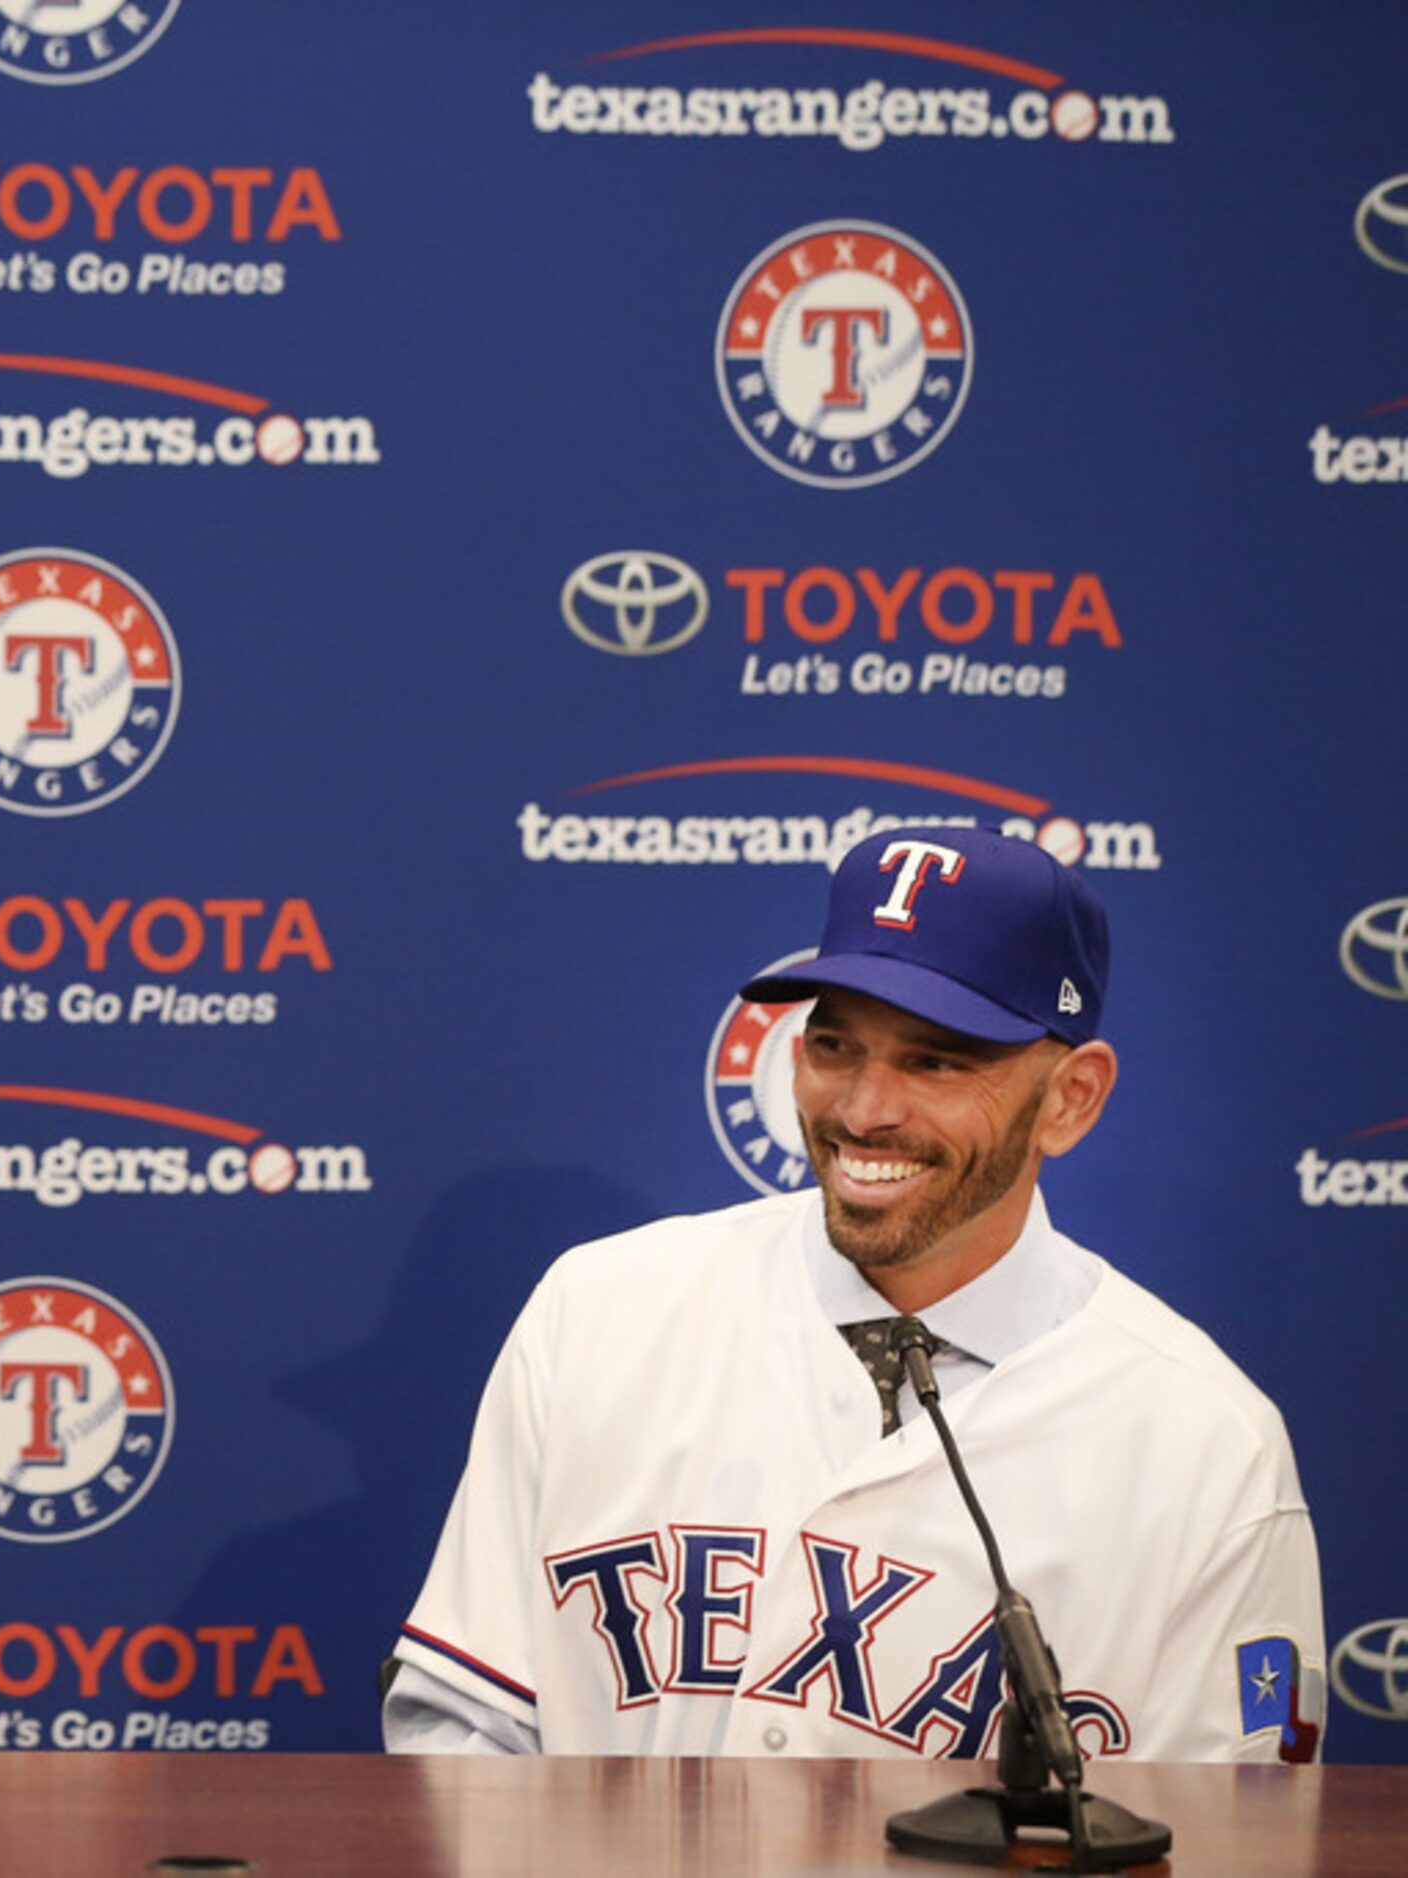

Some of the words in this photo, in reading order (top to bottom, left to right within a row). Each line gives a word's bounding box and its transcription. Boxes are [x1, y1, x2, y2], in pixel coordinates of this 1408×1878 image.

[527, 73, 1174, 150] texasrangers.com
[65, 251, 131, 294] Go
[136, 253, 285, 296] Places
[756, 236, 933, 305] TEXAS
[737, 372, 952, 471] RANGERS
[725, 566, 1122, 648] TOYOTA
[740, 652, 841, 695] Let's
[849, 652, 913, 695] Go
[918, 653, 1066, 699] Places
[873, 839, 966, 932] T
[58, 982, 123, 1025] Go
[128, 984, 277, 1025] Places
[51, 1710, 115, 1749] Go
[122, 1712, 269, 1749] Places
